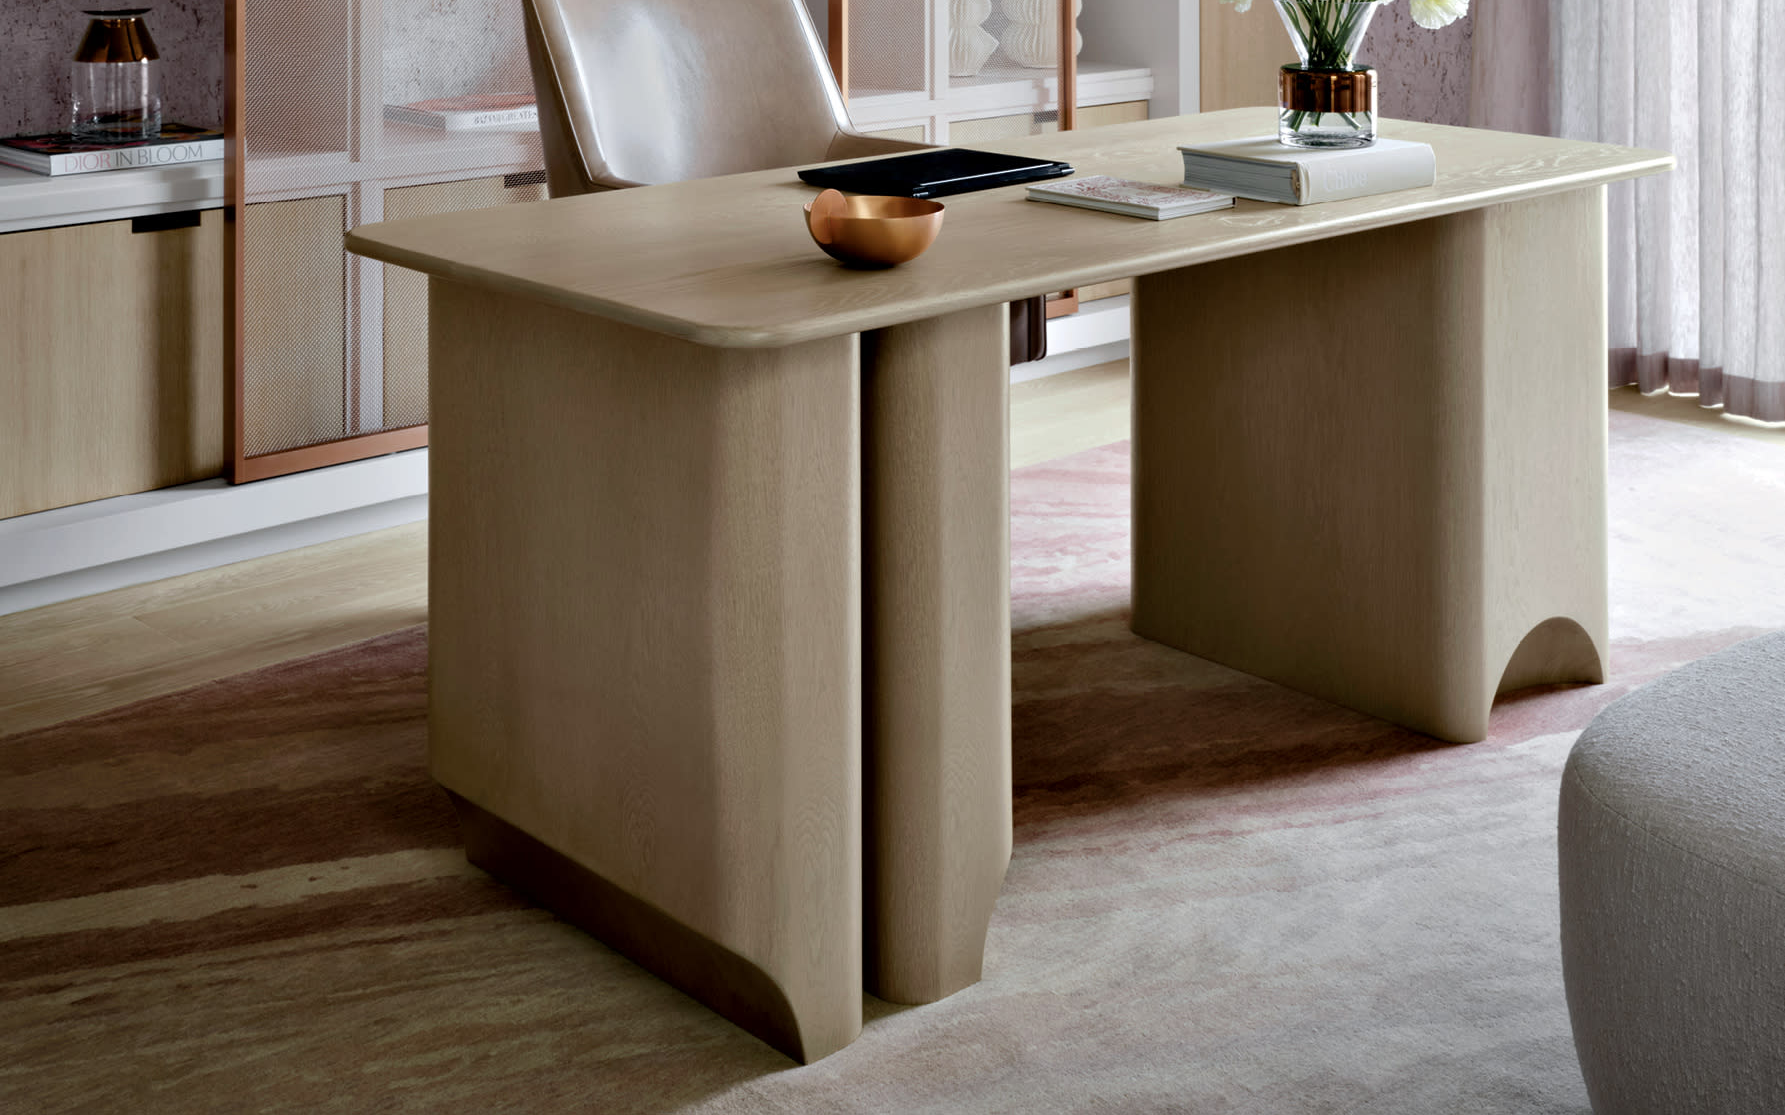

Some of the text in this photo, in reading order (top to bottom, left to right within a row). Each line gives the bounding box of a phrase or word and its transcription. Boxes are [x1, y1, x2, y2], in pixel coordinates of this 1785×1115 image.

[64, 145, 203, 173] DIOR IN BLOOM
